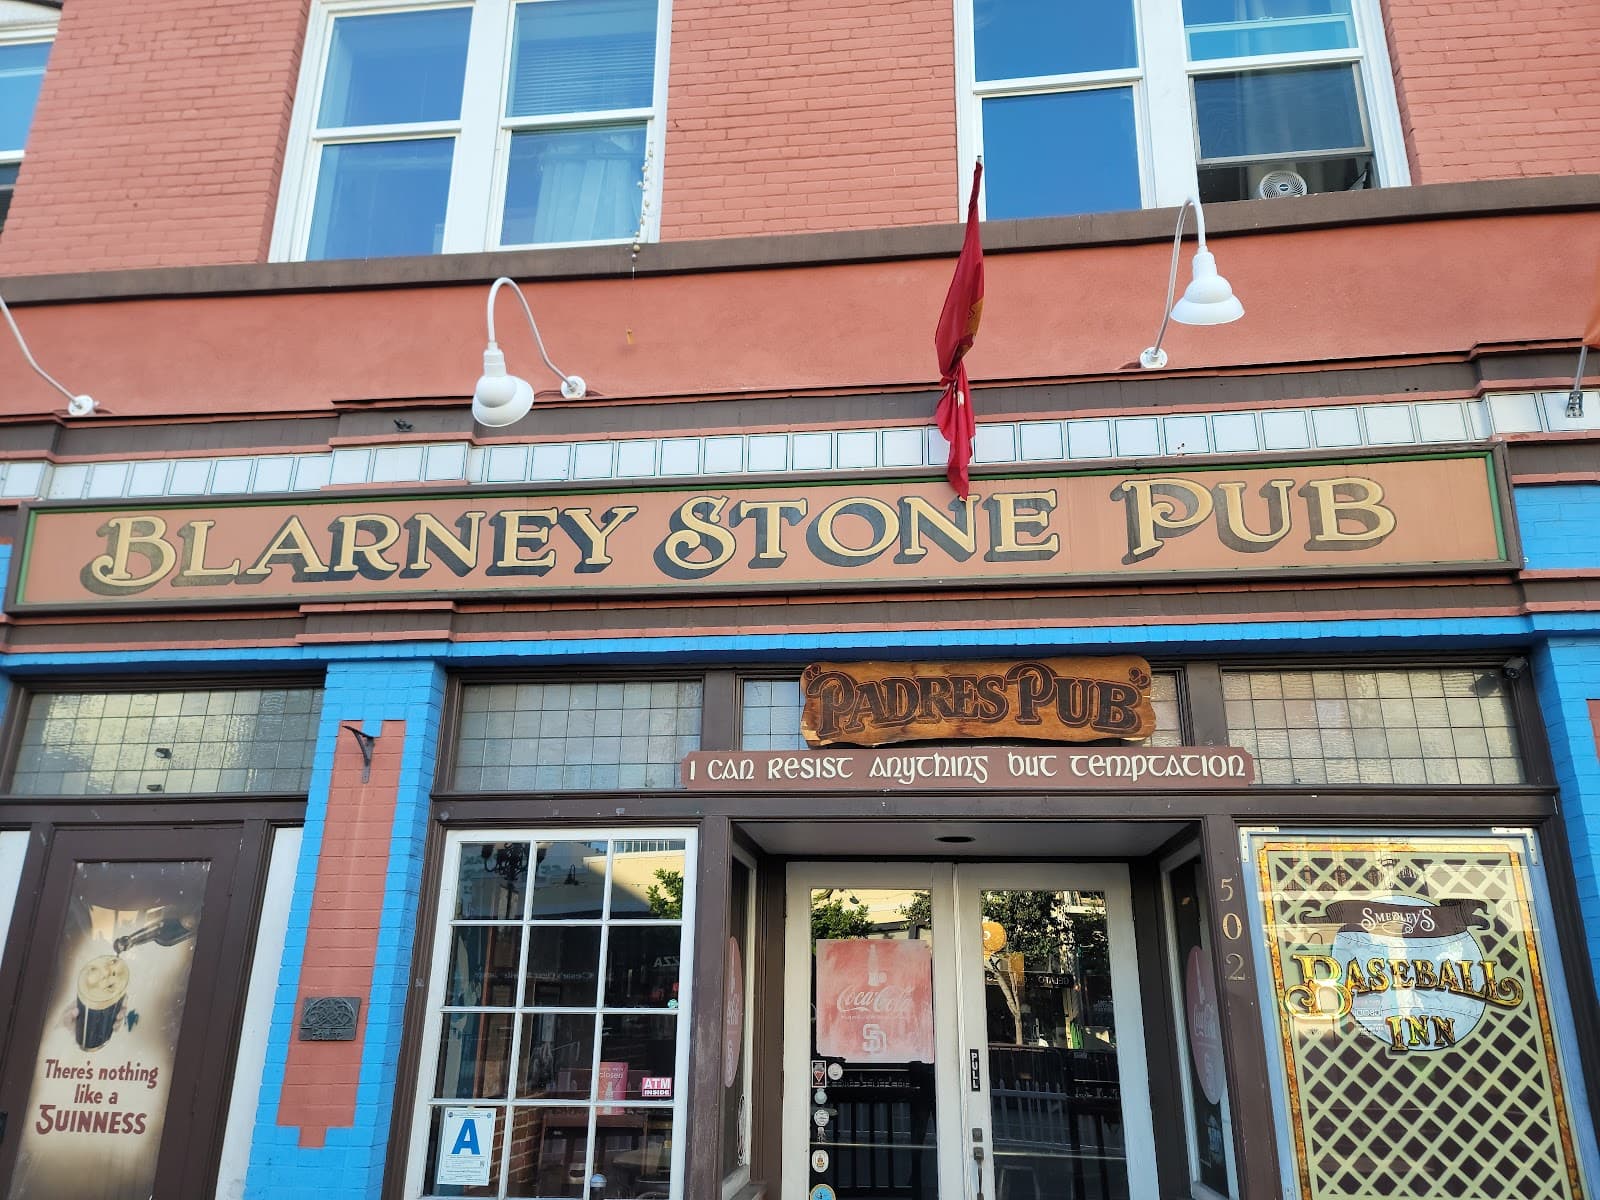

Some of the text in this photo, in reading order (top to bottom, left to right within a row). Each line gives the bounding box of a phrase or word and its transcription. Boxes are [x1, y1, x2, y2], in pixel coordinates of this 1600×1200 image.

[81, 475, 1397, 594] BLARNEY STONE PUB
[1283, 952, 1524, 1020] BASEBALL
[1385, 1013, 1457, 1052] INN
[45, 1059, 158, 1089] There's nothing
[644, 1078, 671, 1089] ATM
[74, 1083, 118, 1104] like a
[36, 1104, 147, 1135] GUINNESS
[452, 1119, 480, 1154] A
